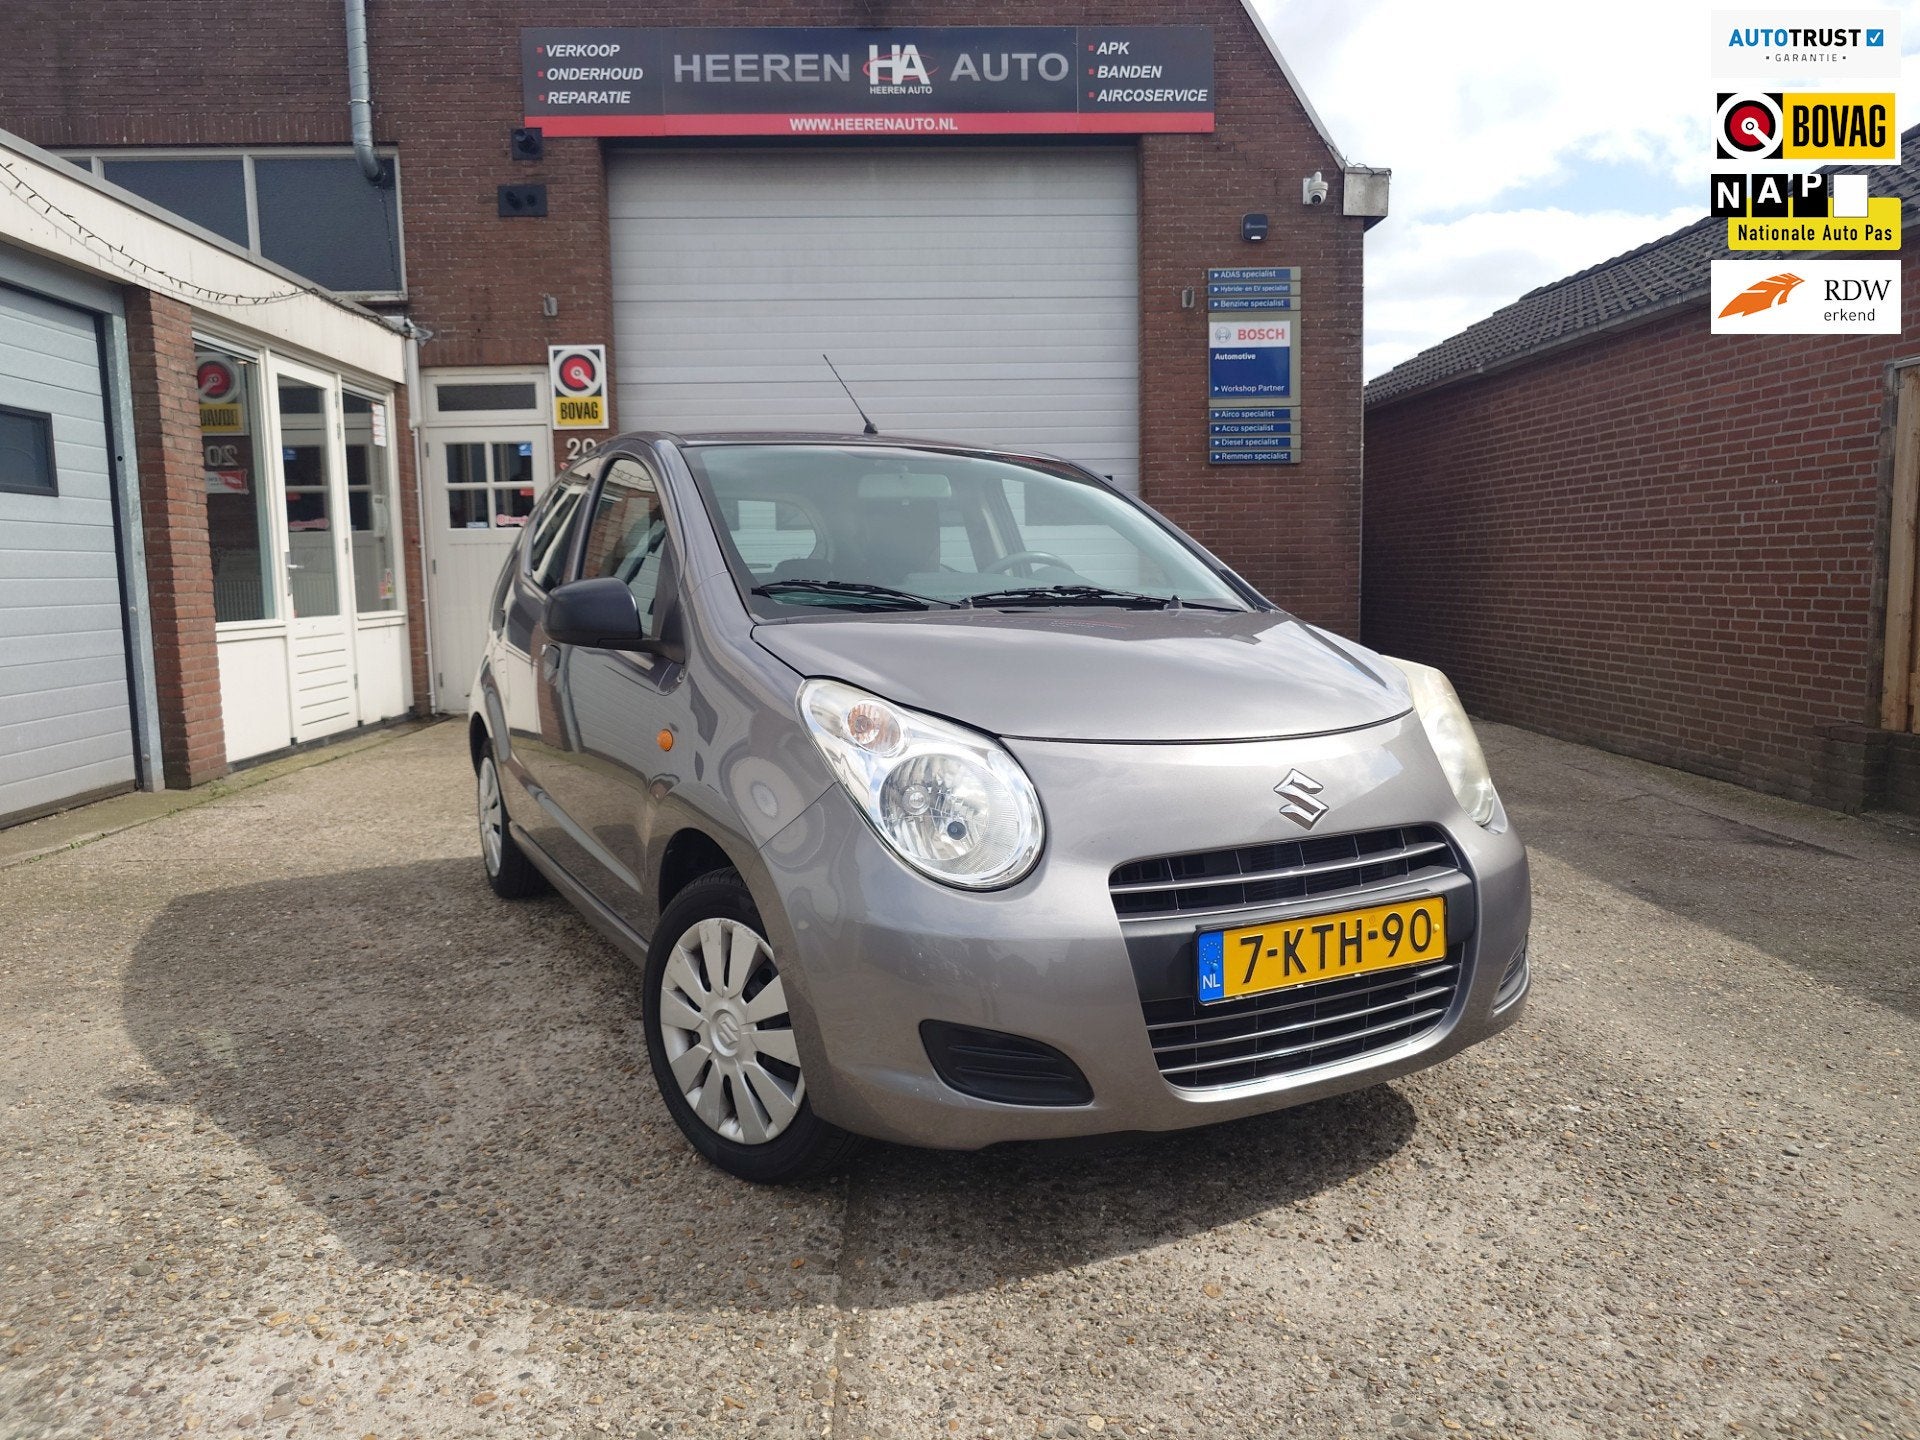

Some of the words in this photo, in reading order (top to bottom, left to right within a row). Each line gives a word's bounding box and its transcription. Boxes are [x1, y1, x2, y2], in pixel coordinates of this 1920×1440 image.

[546, 44, 620, 57] VERKOOP
[1097, 41, 1130, 55] APK
[673, 54, 850, 82] HEEREN
[869, 44, 931, 85] HA
[949, 53, 1069, 82] AUTO
[546, 68, 643, 81] ONDERHOUD
[1097, 65, 1162, 79] BANDEN
[869, 86, 906, 94] HEEREN
[907, 86, 933, 94] AUTO
[1097, 89, 1208, 102] AIRCOSERVICE
[547, 91, 631, 104] REPARATIE
[790, 117, 958, 131] WWW.HEERENAUTO.NL
[1242, 270, 1276, 279] specialist
[1220, 300, 1249, 308] Benzine
[1250, 300, 1284, 308] specialist
[1238, 328, 1285, 340] BOSCH
[1221, 385, 1257, 394] Workshop
[1258, 384, 1285, 392] Partner
[560, 402, 599, 419] BOVAG
[1241, 410, 1275, 418] specialist
[1240, 424, 1274, 432] specialist
[1222, 438, 1244, 446] Diesel
[1245, 438, 1279, 446] specialist
[1254, 452, 1288, 460] specialist
[1240, 908, 1432, 984] 7-KTH-90
[1202, 974, 1221, 990] NL
